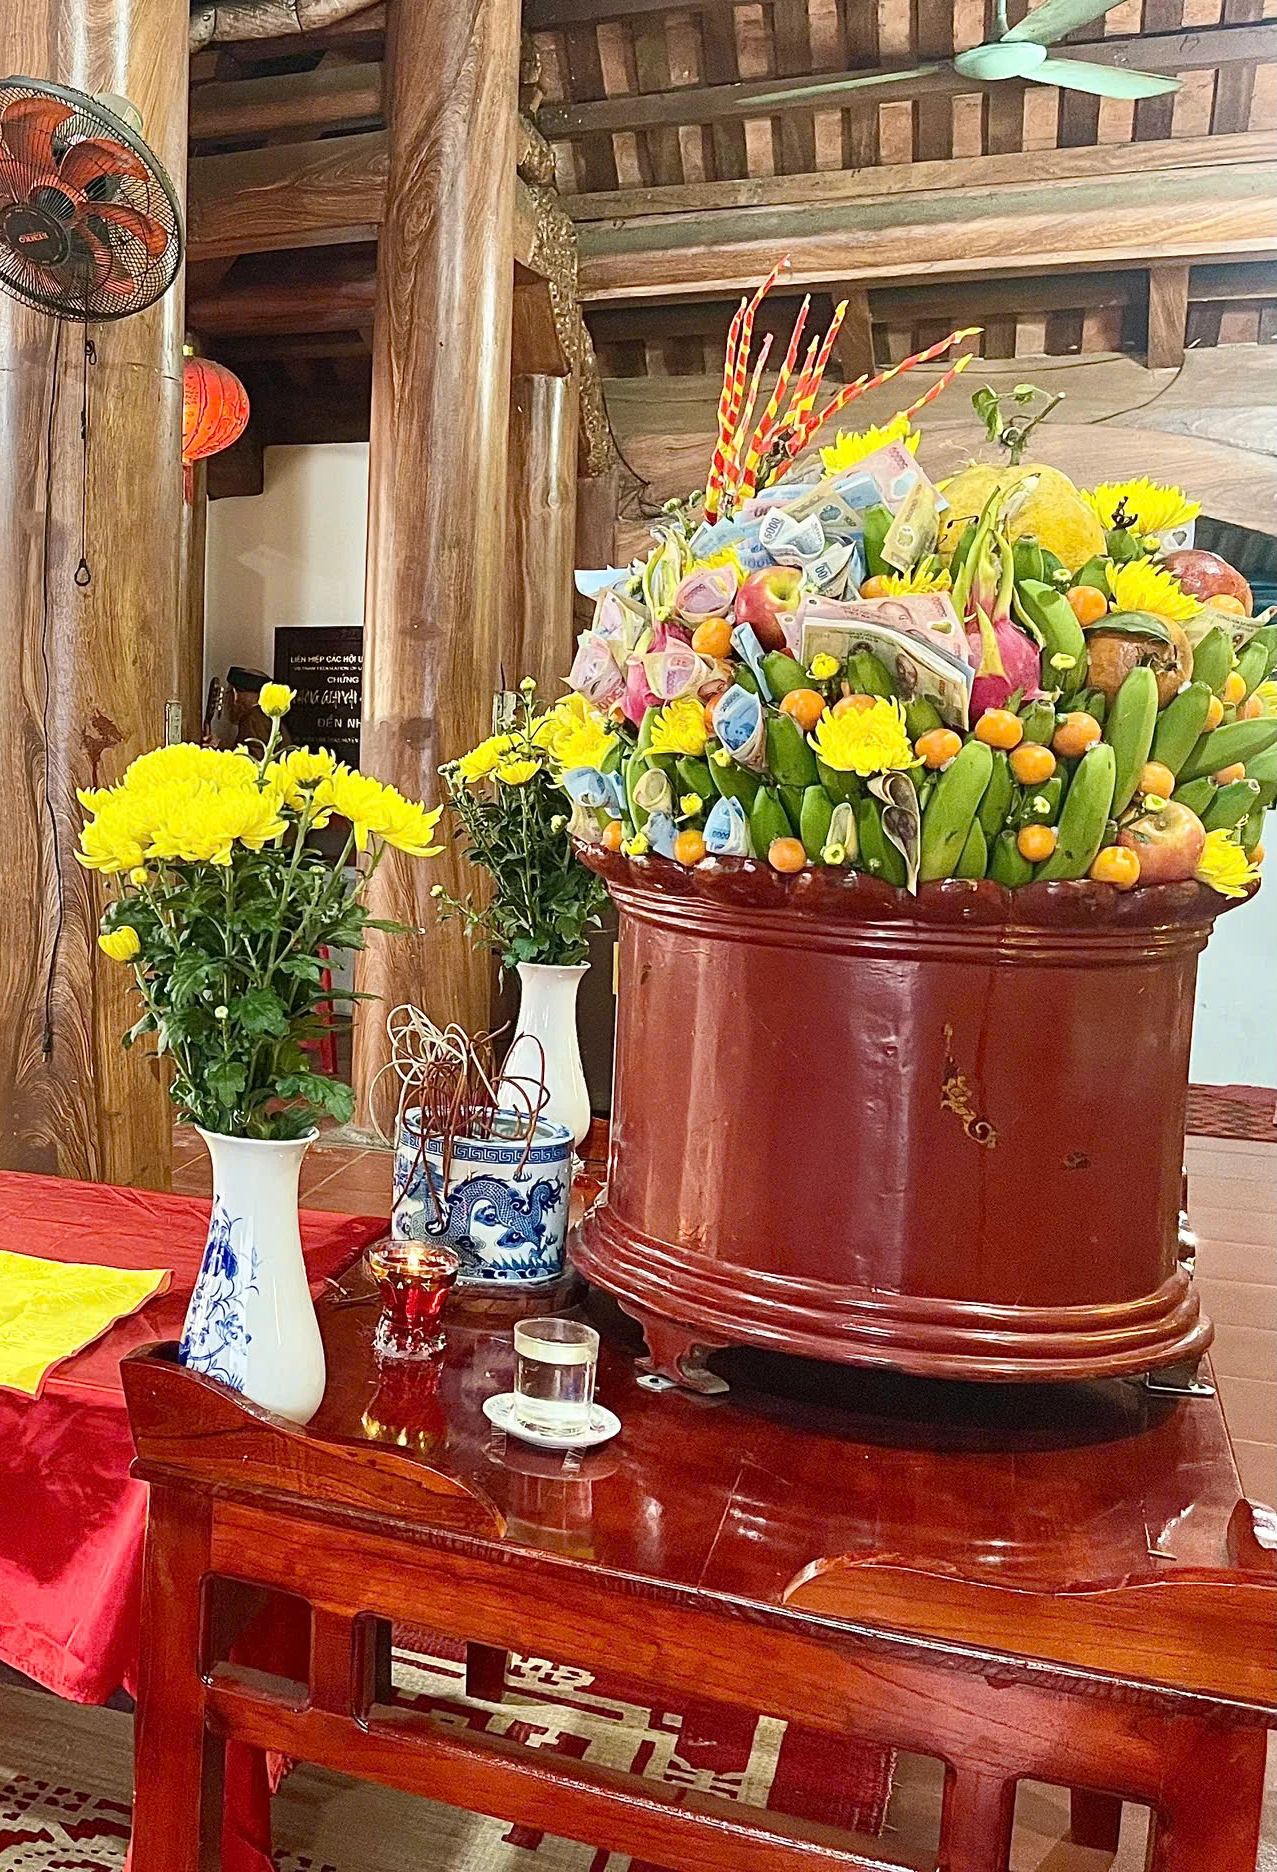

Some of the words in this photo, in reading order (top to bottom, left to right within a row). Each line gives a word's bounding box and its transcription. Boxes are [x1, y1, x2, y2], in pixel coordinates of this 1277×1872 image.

[326, 653, 342, 664] CÁC
[343, 653, 357, 664] HỘI
[327, 673, 359, 683] CHỨNG
